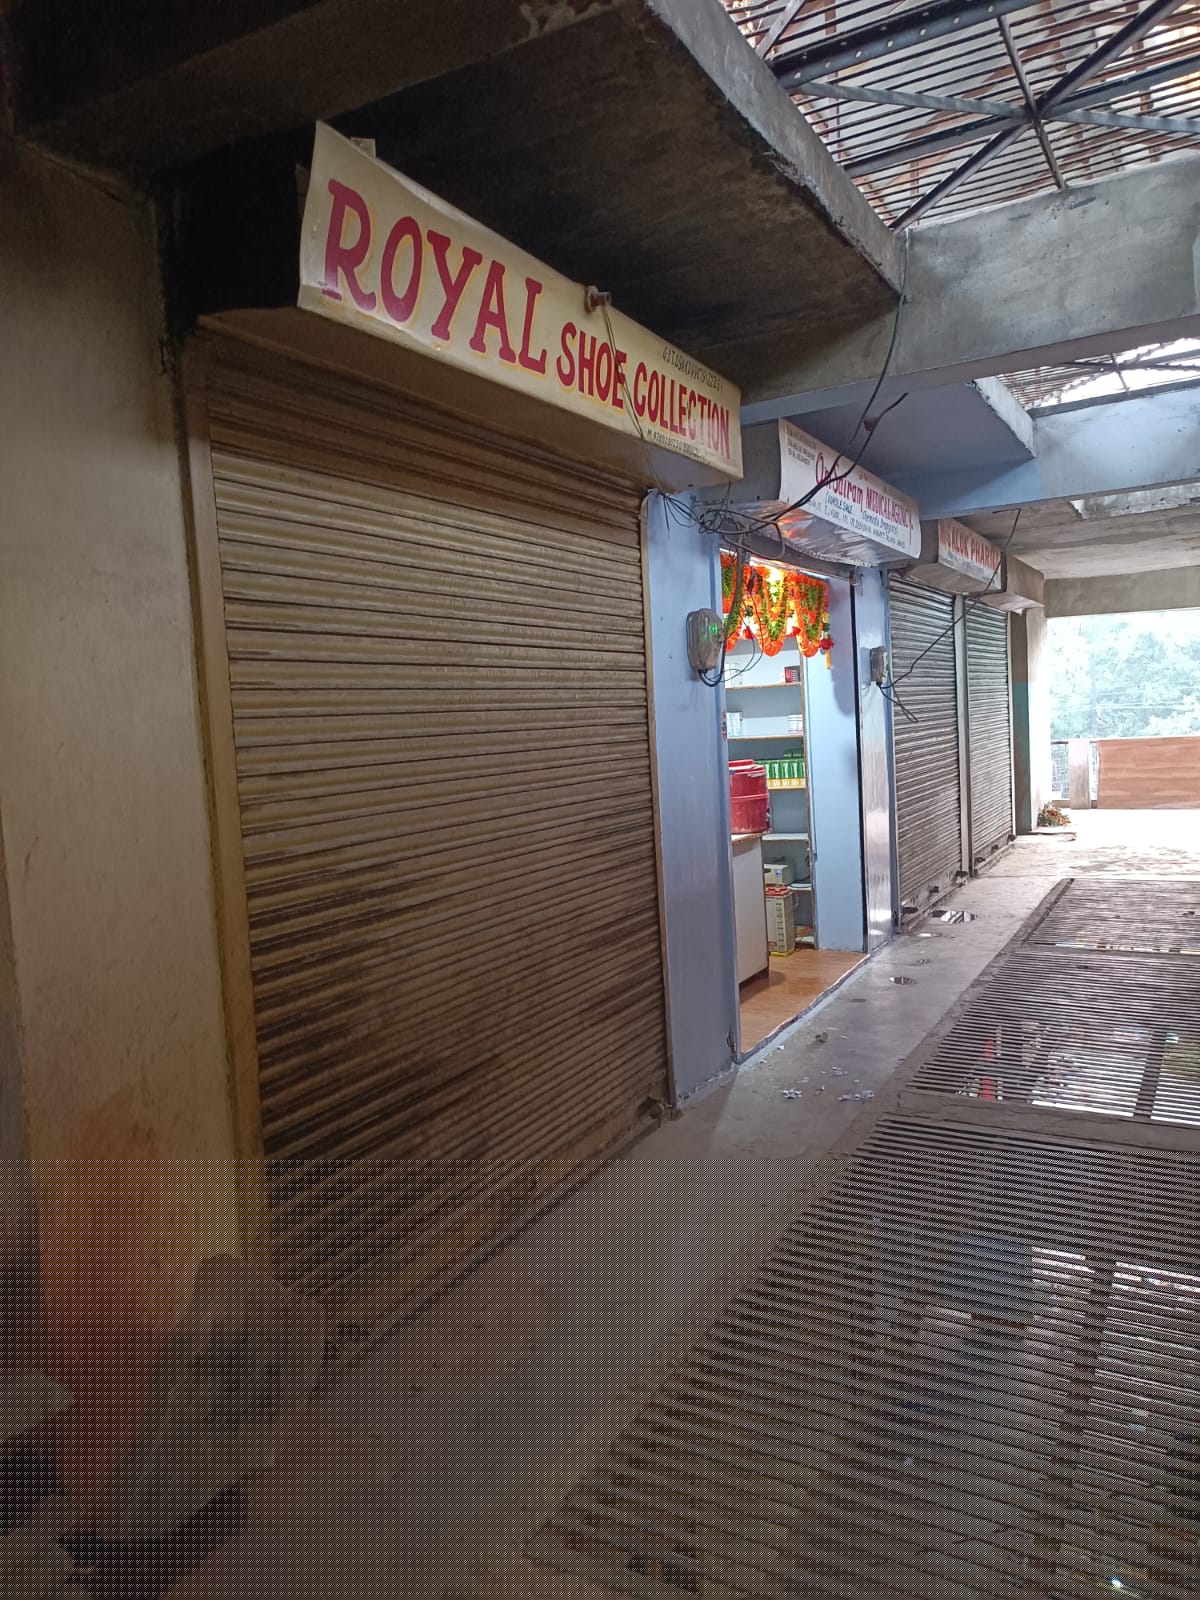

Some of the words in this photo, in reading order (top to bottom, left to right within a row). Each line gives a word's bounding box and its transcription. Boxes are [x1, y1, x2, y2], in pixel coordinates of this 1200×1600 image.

[322, 179, 546, 374] ROYAL
[556, 321, 628, 410] SHOE
[633, 361, 731, 460] COLLECTION
